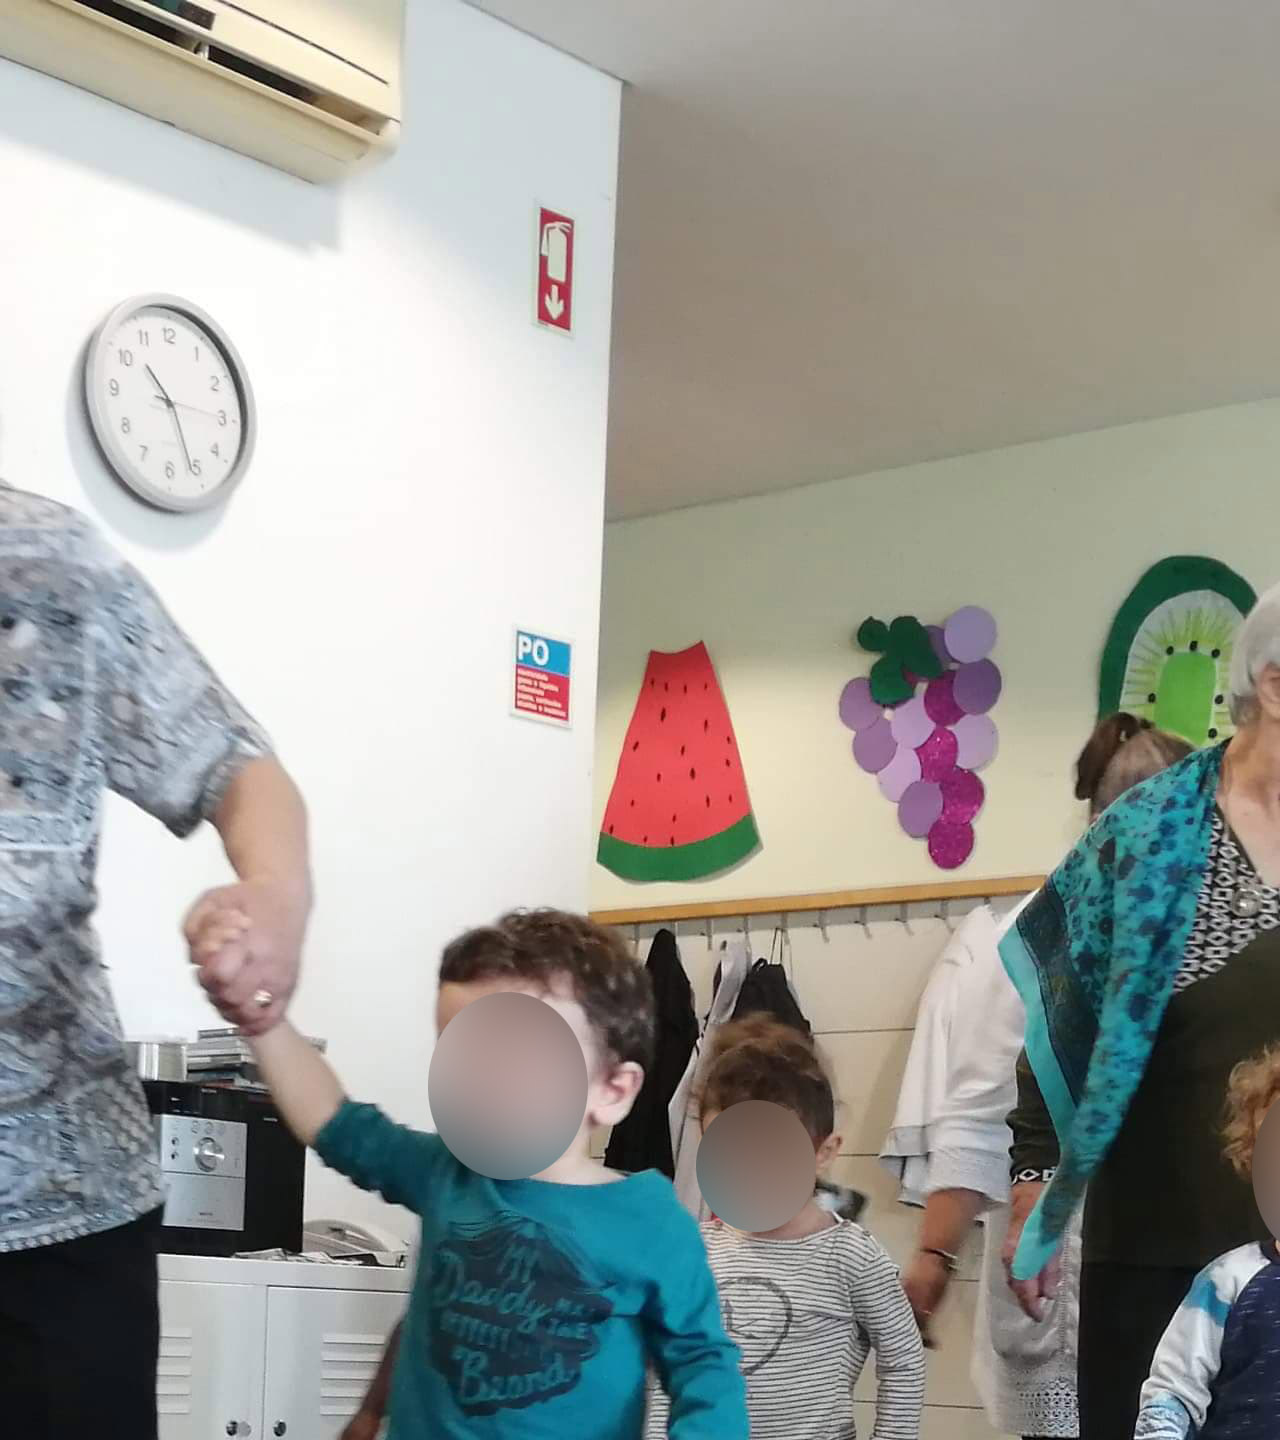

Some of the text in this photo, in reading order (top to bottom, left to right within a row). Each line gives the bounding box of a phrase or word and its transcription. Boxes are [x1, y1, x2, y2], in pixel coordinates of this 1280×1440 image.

[138, 329, 150, 347] 11
[162, 327, 176, 345] 12
[119, 348, 133, 367] 10
[108, 378, 120, 397] 9
[210, 375, 220, 392] 2
[121, 417, 131, 434] 8
[217, 410, 227, 426] 3
[138, 444, 149, 461] 7
[210, 442, 219, 457] 4
[165, 460, 175, 478] 6
[191, 459, 202, 476] 5
[518, 635, 549, 666] PO
[431, 1251, 553, 1335] Daddy
